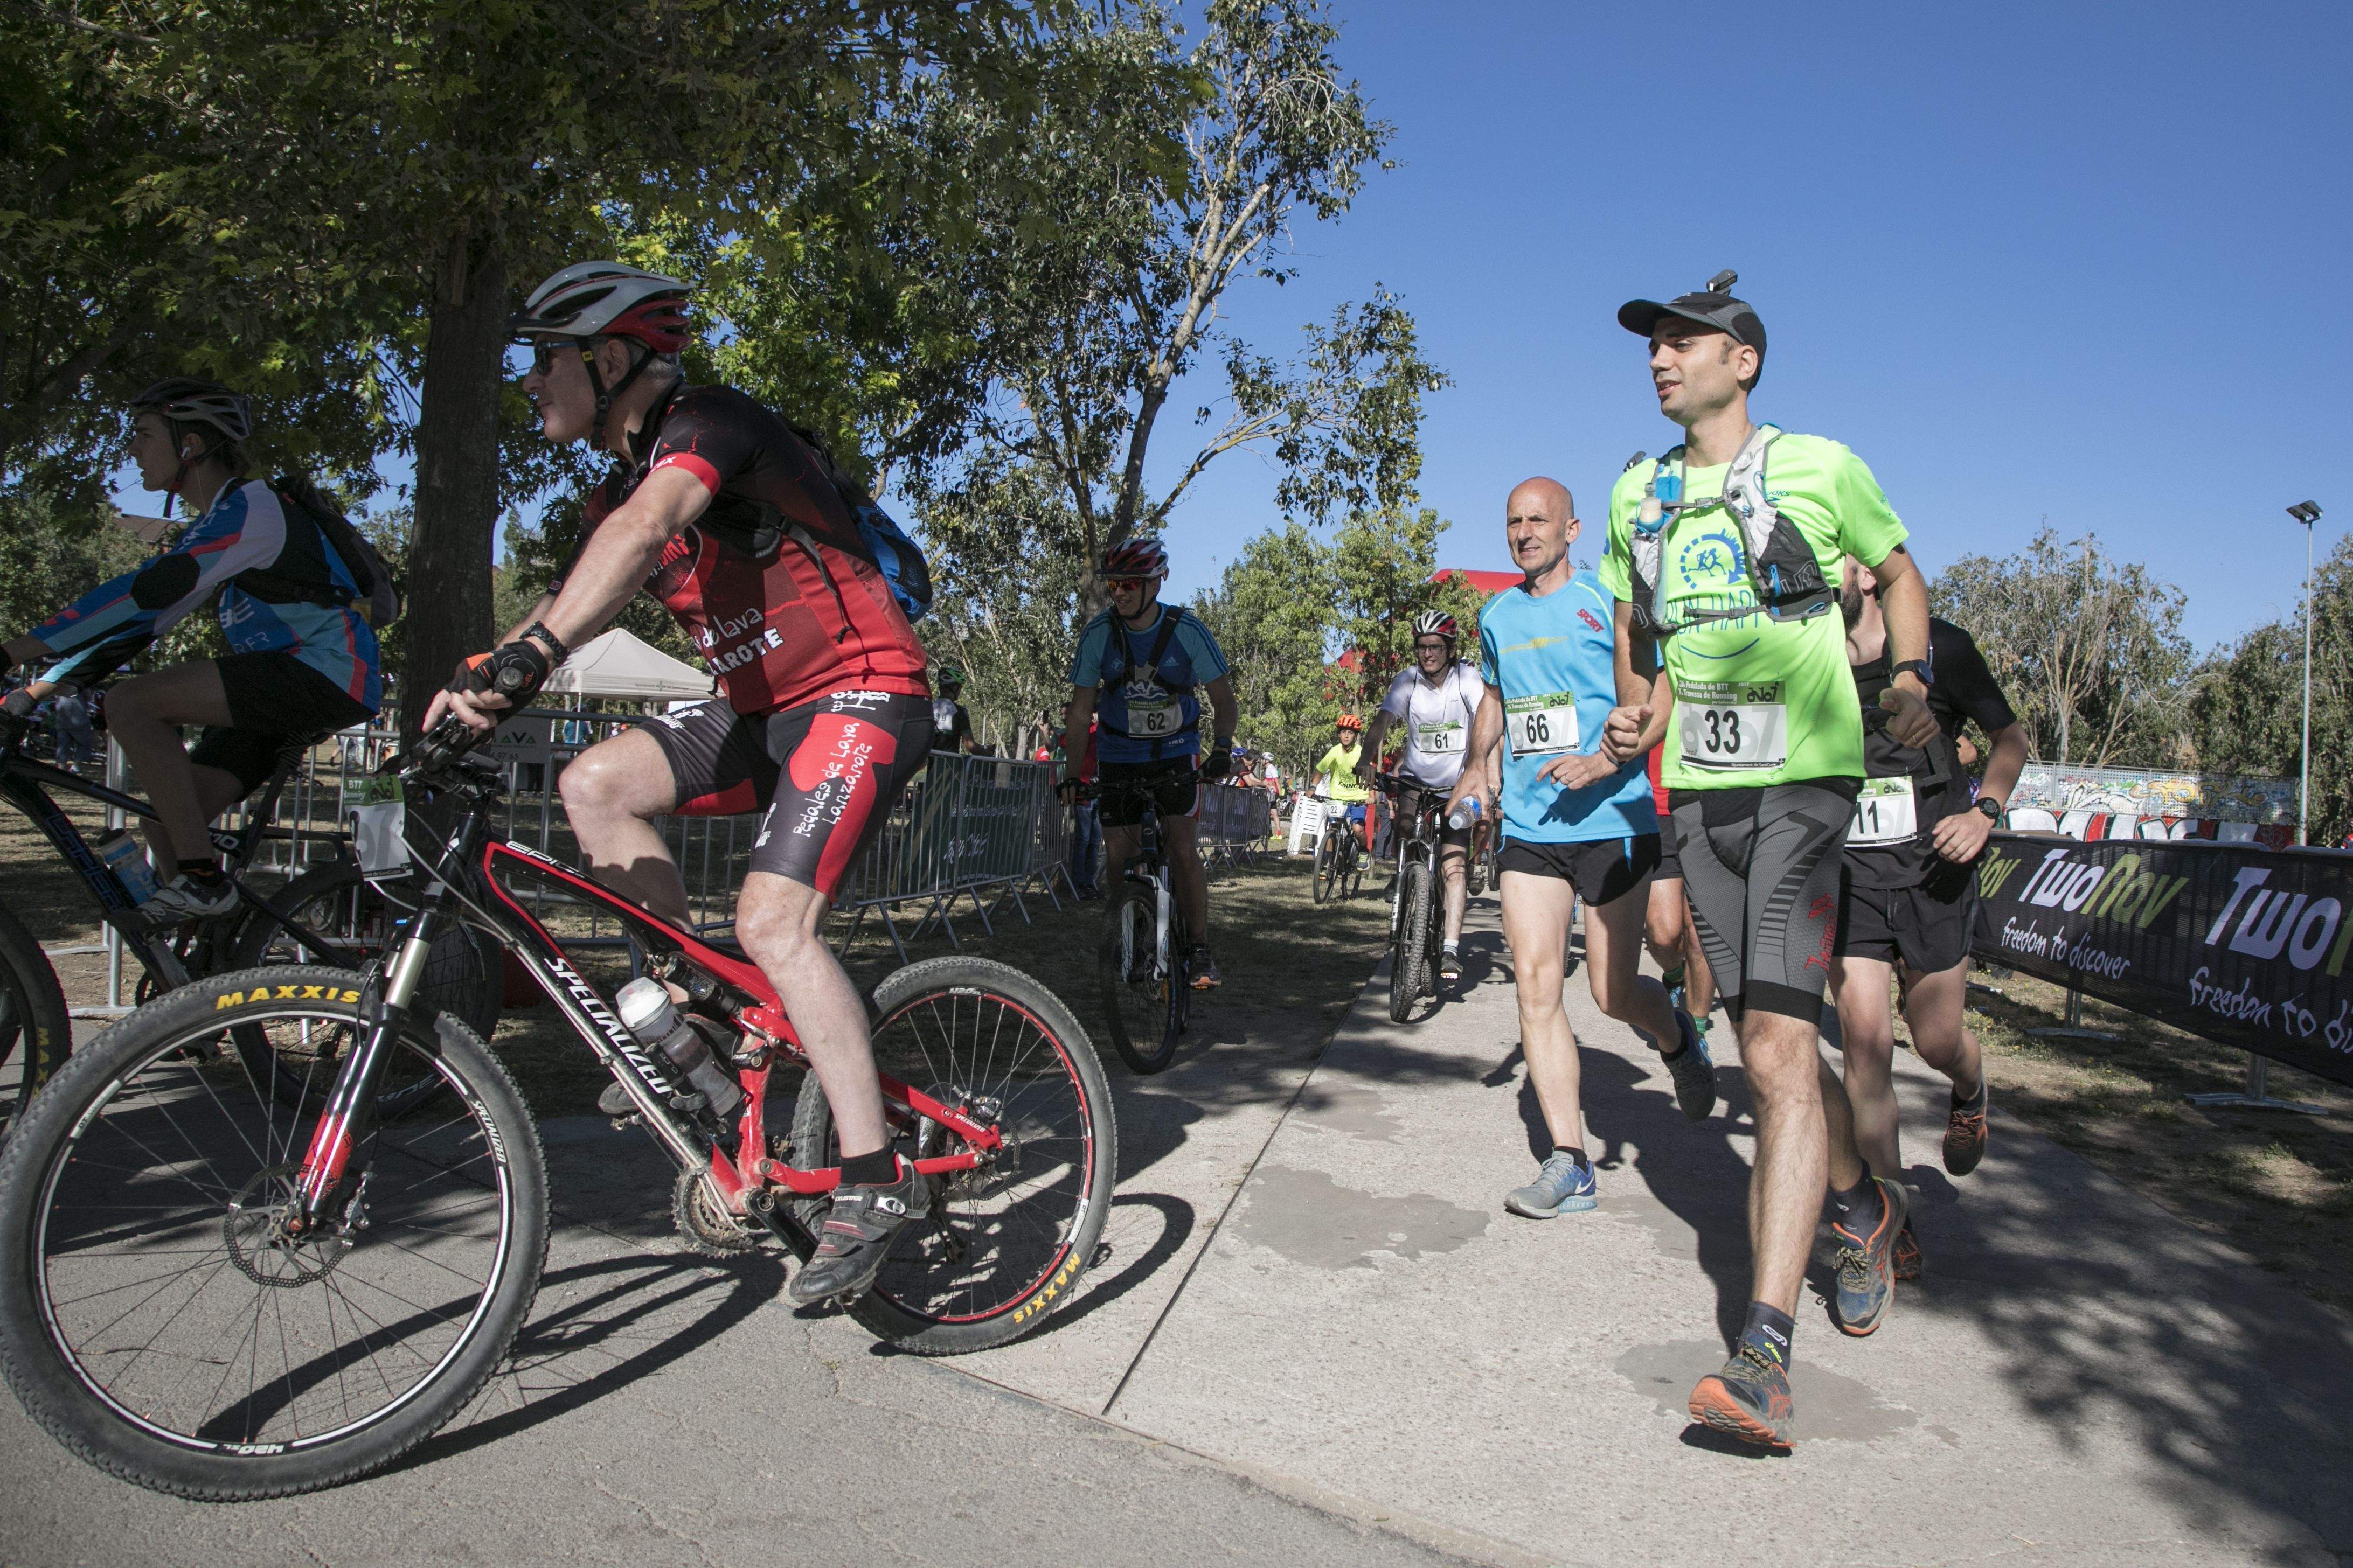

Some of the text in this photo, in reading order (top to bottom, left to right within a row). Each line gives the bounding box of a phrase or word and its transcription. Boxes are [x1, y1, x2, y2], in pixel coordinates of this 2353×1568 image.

[219, 598, 254, 629] BE
[713, 608, 763, 638] lava
[1577, 608, 1604, 633] SPORT
[712, 627, 783, 673] AROTE
[1683, 689, 1702, 699] Travessa
[1712, 692, 1737, 701] Running
[1686, 681, 1706, 691] Pedalada
[1148, 712, 1165, 731] 62
[1527, 714, 1549, 744] 66
[1705, 709, 1741, 754] 33
[830, 723, 860, 758] Lava
[1435, 733, 1448, 749] 61
[349, 780, 363, 789] BTT
[822, 761, 844, 779] de
[822, 743, 873, 825] Lanzarote
[793, 782, 831, 837] Pedales
[1331, 806, 1337, 814] 22
[505, 840, 579, 874] EPIC
[2018, 848, 2189, 929] TwoNav
[2001, 916, 2131, 979] freedom to discover
[216, 985, 360, 1010] MAXXIS
[2189, 966, 2272, 1028] freedom
[2281, 992, 2316, 1037] to
[543, 958, 673, 1093] SPECIALIZED
[474, 1100, 506, 1163] SPECIALIZED
[954, 1113, 986, 1132] SPECIALIZED
[1014, 1252, 1081, 1323] MAXXIS
